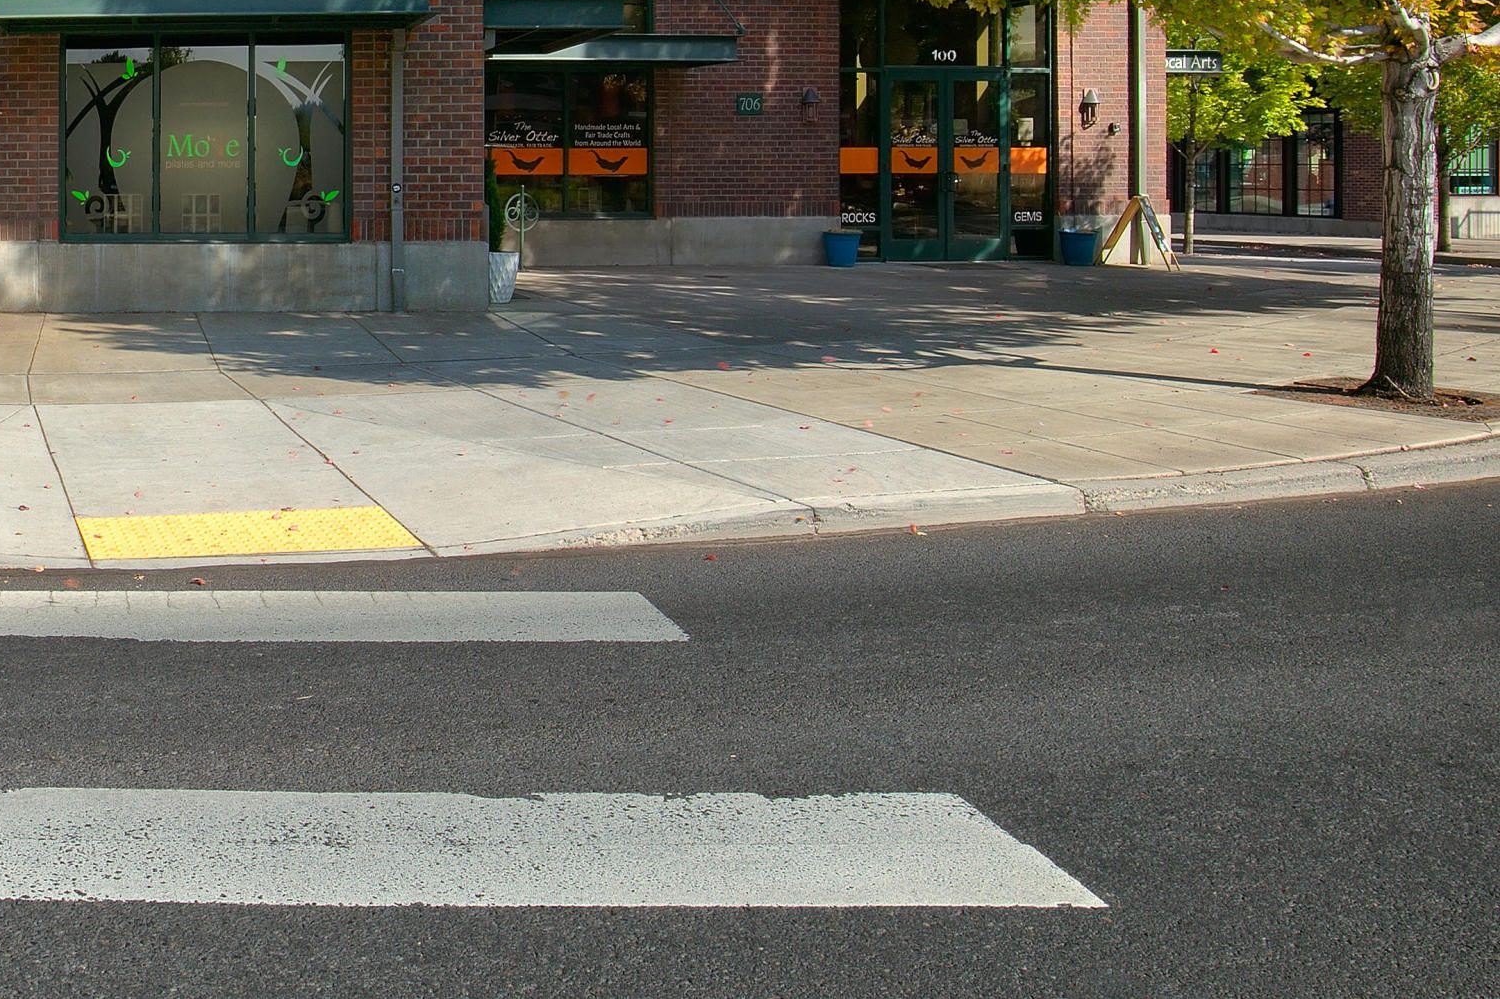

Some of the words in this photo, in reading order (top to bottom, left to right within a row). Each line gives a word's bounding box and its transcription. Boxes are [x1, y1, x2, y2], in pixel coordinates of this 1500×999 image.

[931, 49, 957, 62] 100
[1190, 54, 1218, 69] Arts
[739, 97, 761, 111] 706
[513, 121, 532, 131] The
[574, 123, 606, 131] Handmade
[607, 123, 622, 131] Local
[623, 123, 635, 131] Arts
[488, 130, 521, 142] Silver
[525, 130, 559, 142] Otter
[585, 131, 596, 139] Fair
[597, 131, 613, 139] Trade
[613, 131, 630, 139] Crafts
[955, 135, 975, 144] Silver
[977, 135, 998, 144] Otter
[574, 139, 589, 147] from
[589, 139, 612, 147] Around
[612, 139, 622, 147] the
[622, 139, 642, 147] World
[841, 212, 876, 223] ROCKS
[1014, 211, 1043, 222] GEMS
